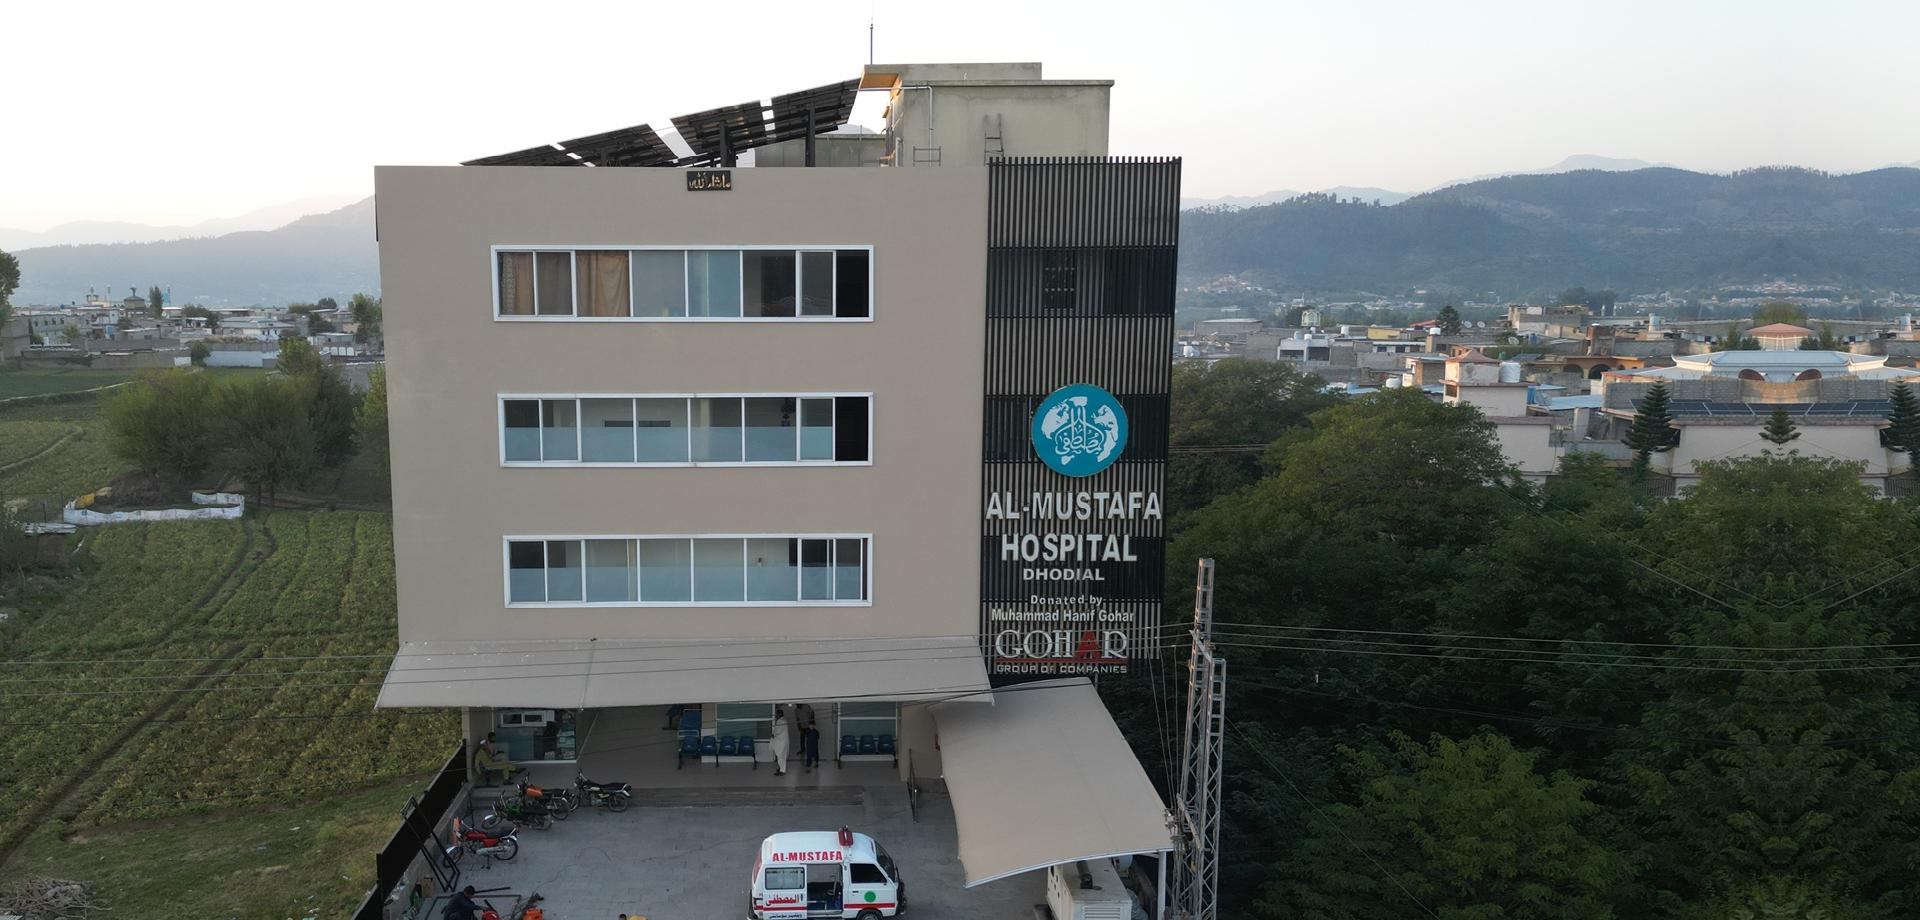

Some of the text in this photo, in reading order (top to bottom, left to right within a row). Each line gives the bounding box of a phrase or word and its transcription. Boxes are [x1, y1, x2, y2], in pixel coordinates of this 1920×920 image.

[985, 492, 1162, 520] AL-MUSTAFA
[1001, 533, 1137, 562] HOSPITAL
[1023, 568, 1105, 581] DHODIAL
[1030, 595, 1103, 606] Donated by
[991, 609, 1134, 622] Muhammad Hanif Gohar
[995, 629, 1128, 659] GOHAR
[996, 665, 1036, 674] GROUP
[1060, 665, 1127, 674] COMPANIES
[772, 850, 843, 862] AL-MUSTAFA
